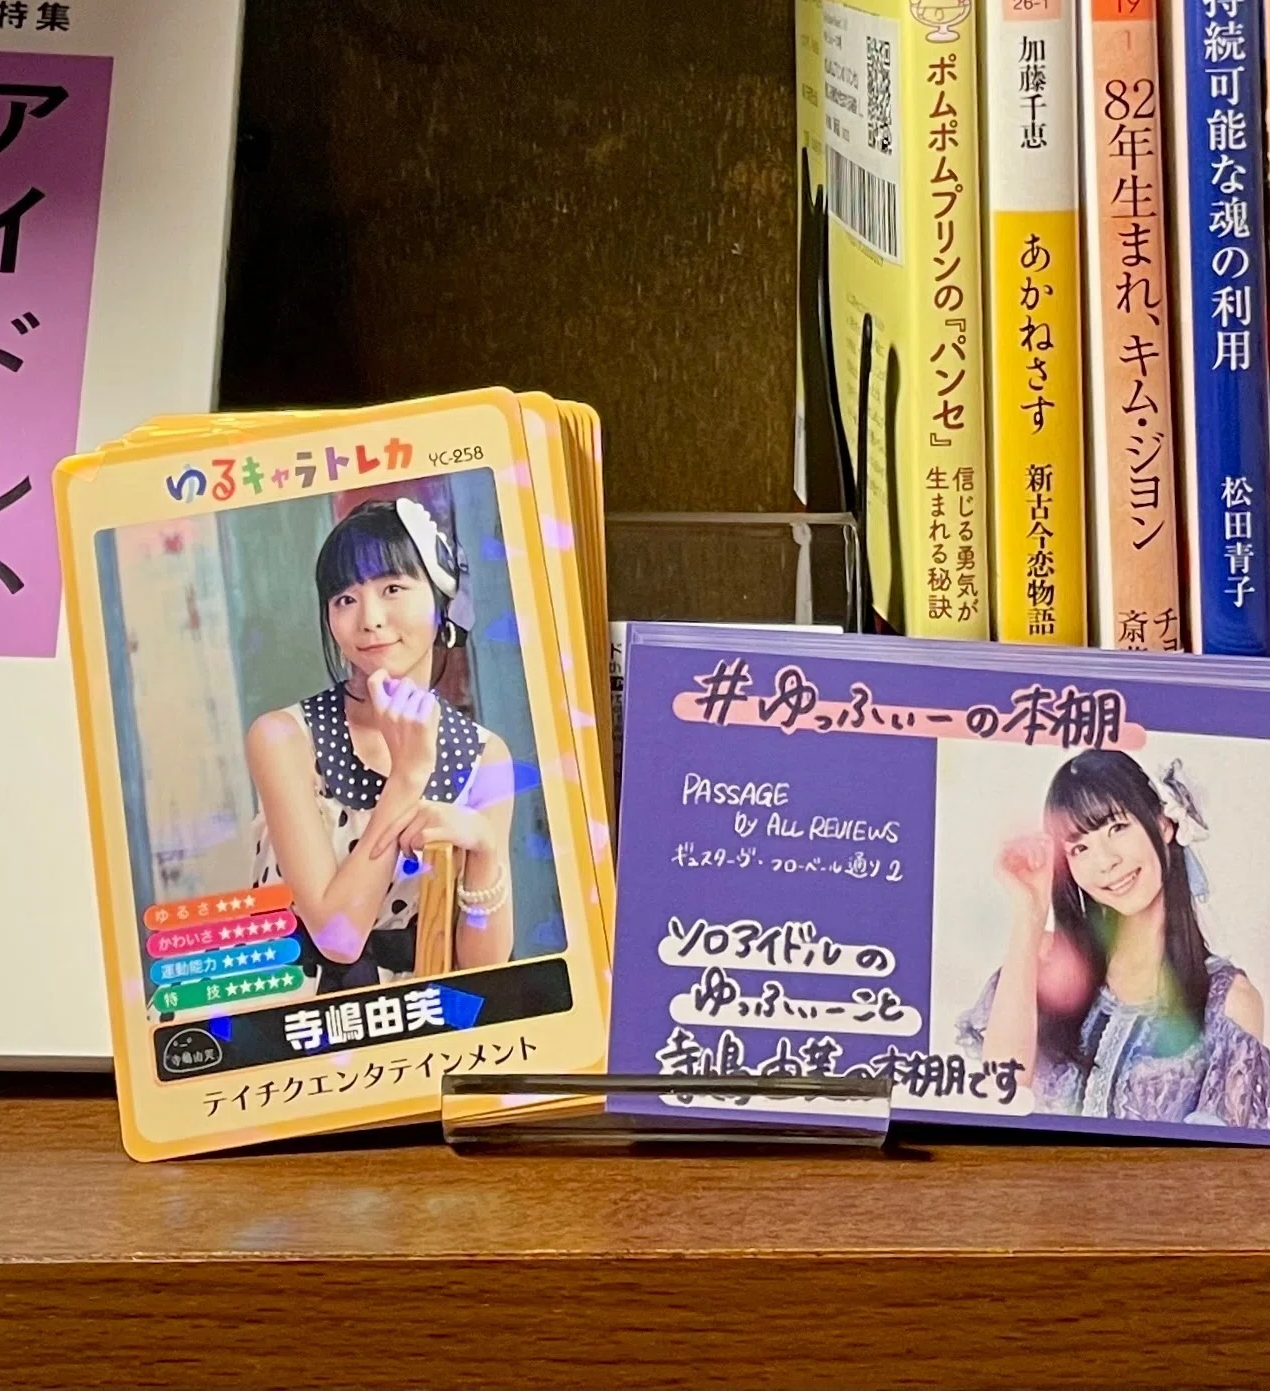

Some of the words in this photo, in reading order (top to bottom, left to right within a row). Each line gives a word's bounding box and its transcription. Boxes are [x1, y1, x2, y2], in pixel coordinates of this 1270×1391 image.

[1018, 35, 1048, 150] 加藤千恵
[925, 55, 969, 450] ポムポムプリンの『パンセ』
[1018, 231, 1054, 436] あかねさす
[1103, 78, 1166, 550] 82年生まれ、キム・ジヨン
[165, 436, 414, 504] ゆるキャラトレカ
[427, 445, 485, 468] YC-258
[925, 466, 953, 620] 生まれる秘訣
[952, 467, 979, 622] 信じる勇気が
[1024, 462, 1057, 636] 新古今恋物語
[1220, 475, 1258, 609] 松田青子
[682, 772, 790, 807] PASSAGE
[734, 810, 759, 837] by
[766, 811, 805, 837] ALL
[808, 814, 901, 843] REVIEWS
[158, 929, 214, 952] かわいさ
[160, 957, 218, 979] 運動能力
[670, 919, 887, 972] ソロアイドルの
[282, 986, 447, 1050] 寺嶋由芙
[202, 1034, 540, 1117] テイチクエンタテインメント
